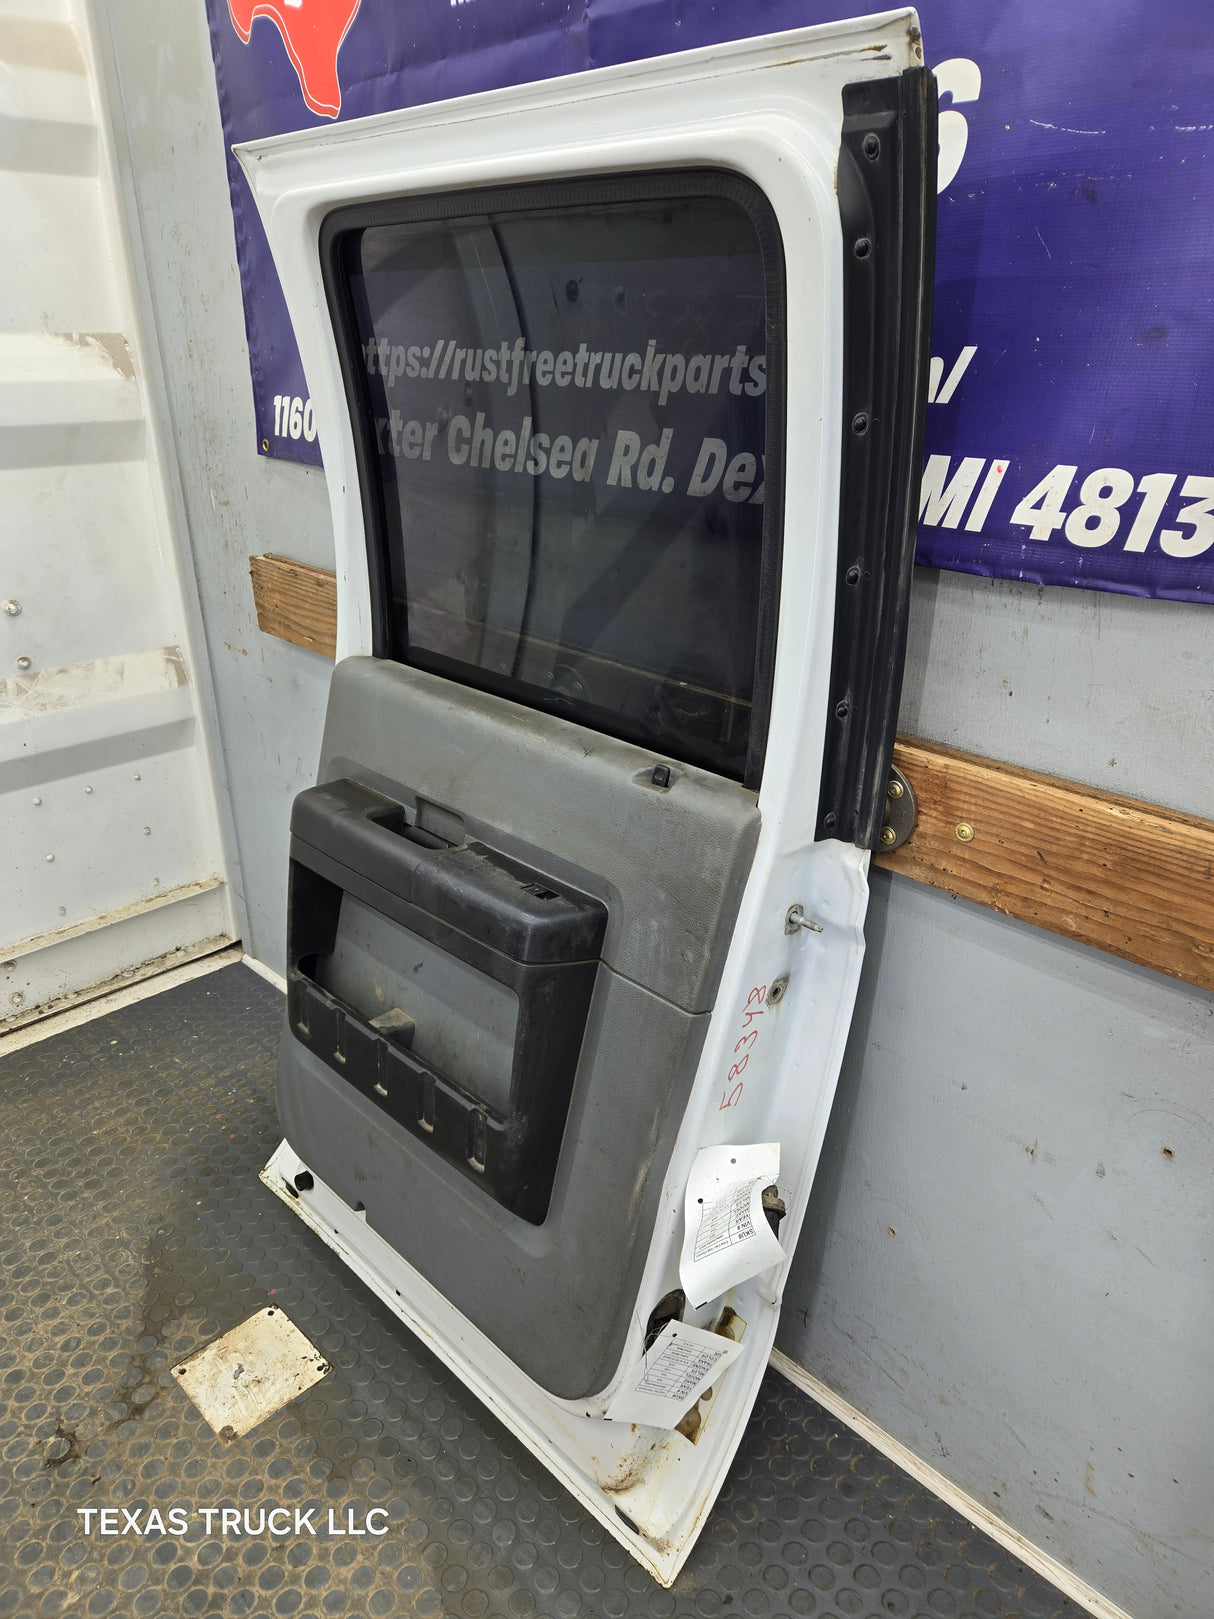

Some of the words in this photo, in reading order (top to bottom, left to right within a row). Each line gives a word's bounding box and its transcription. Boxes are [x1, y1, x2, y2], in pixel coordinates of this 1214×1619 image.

[362, 338, 767, 406] ttps://rustfreetruckparts
[448, 412, 599, 483] Chelsea
[607, 428, 675, 494] Rd.
[919, 455, 1010, 533] MI
[1010, 465, 1214, 558] 4813
